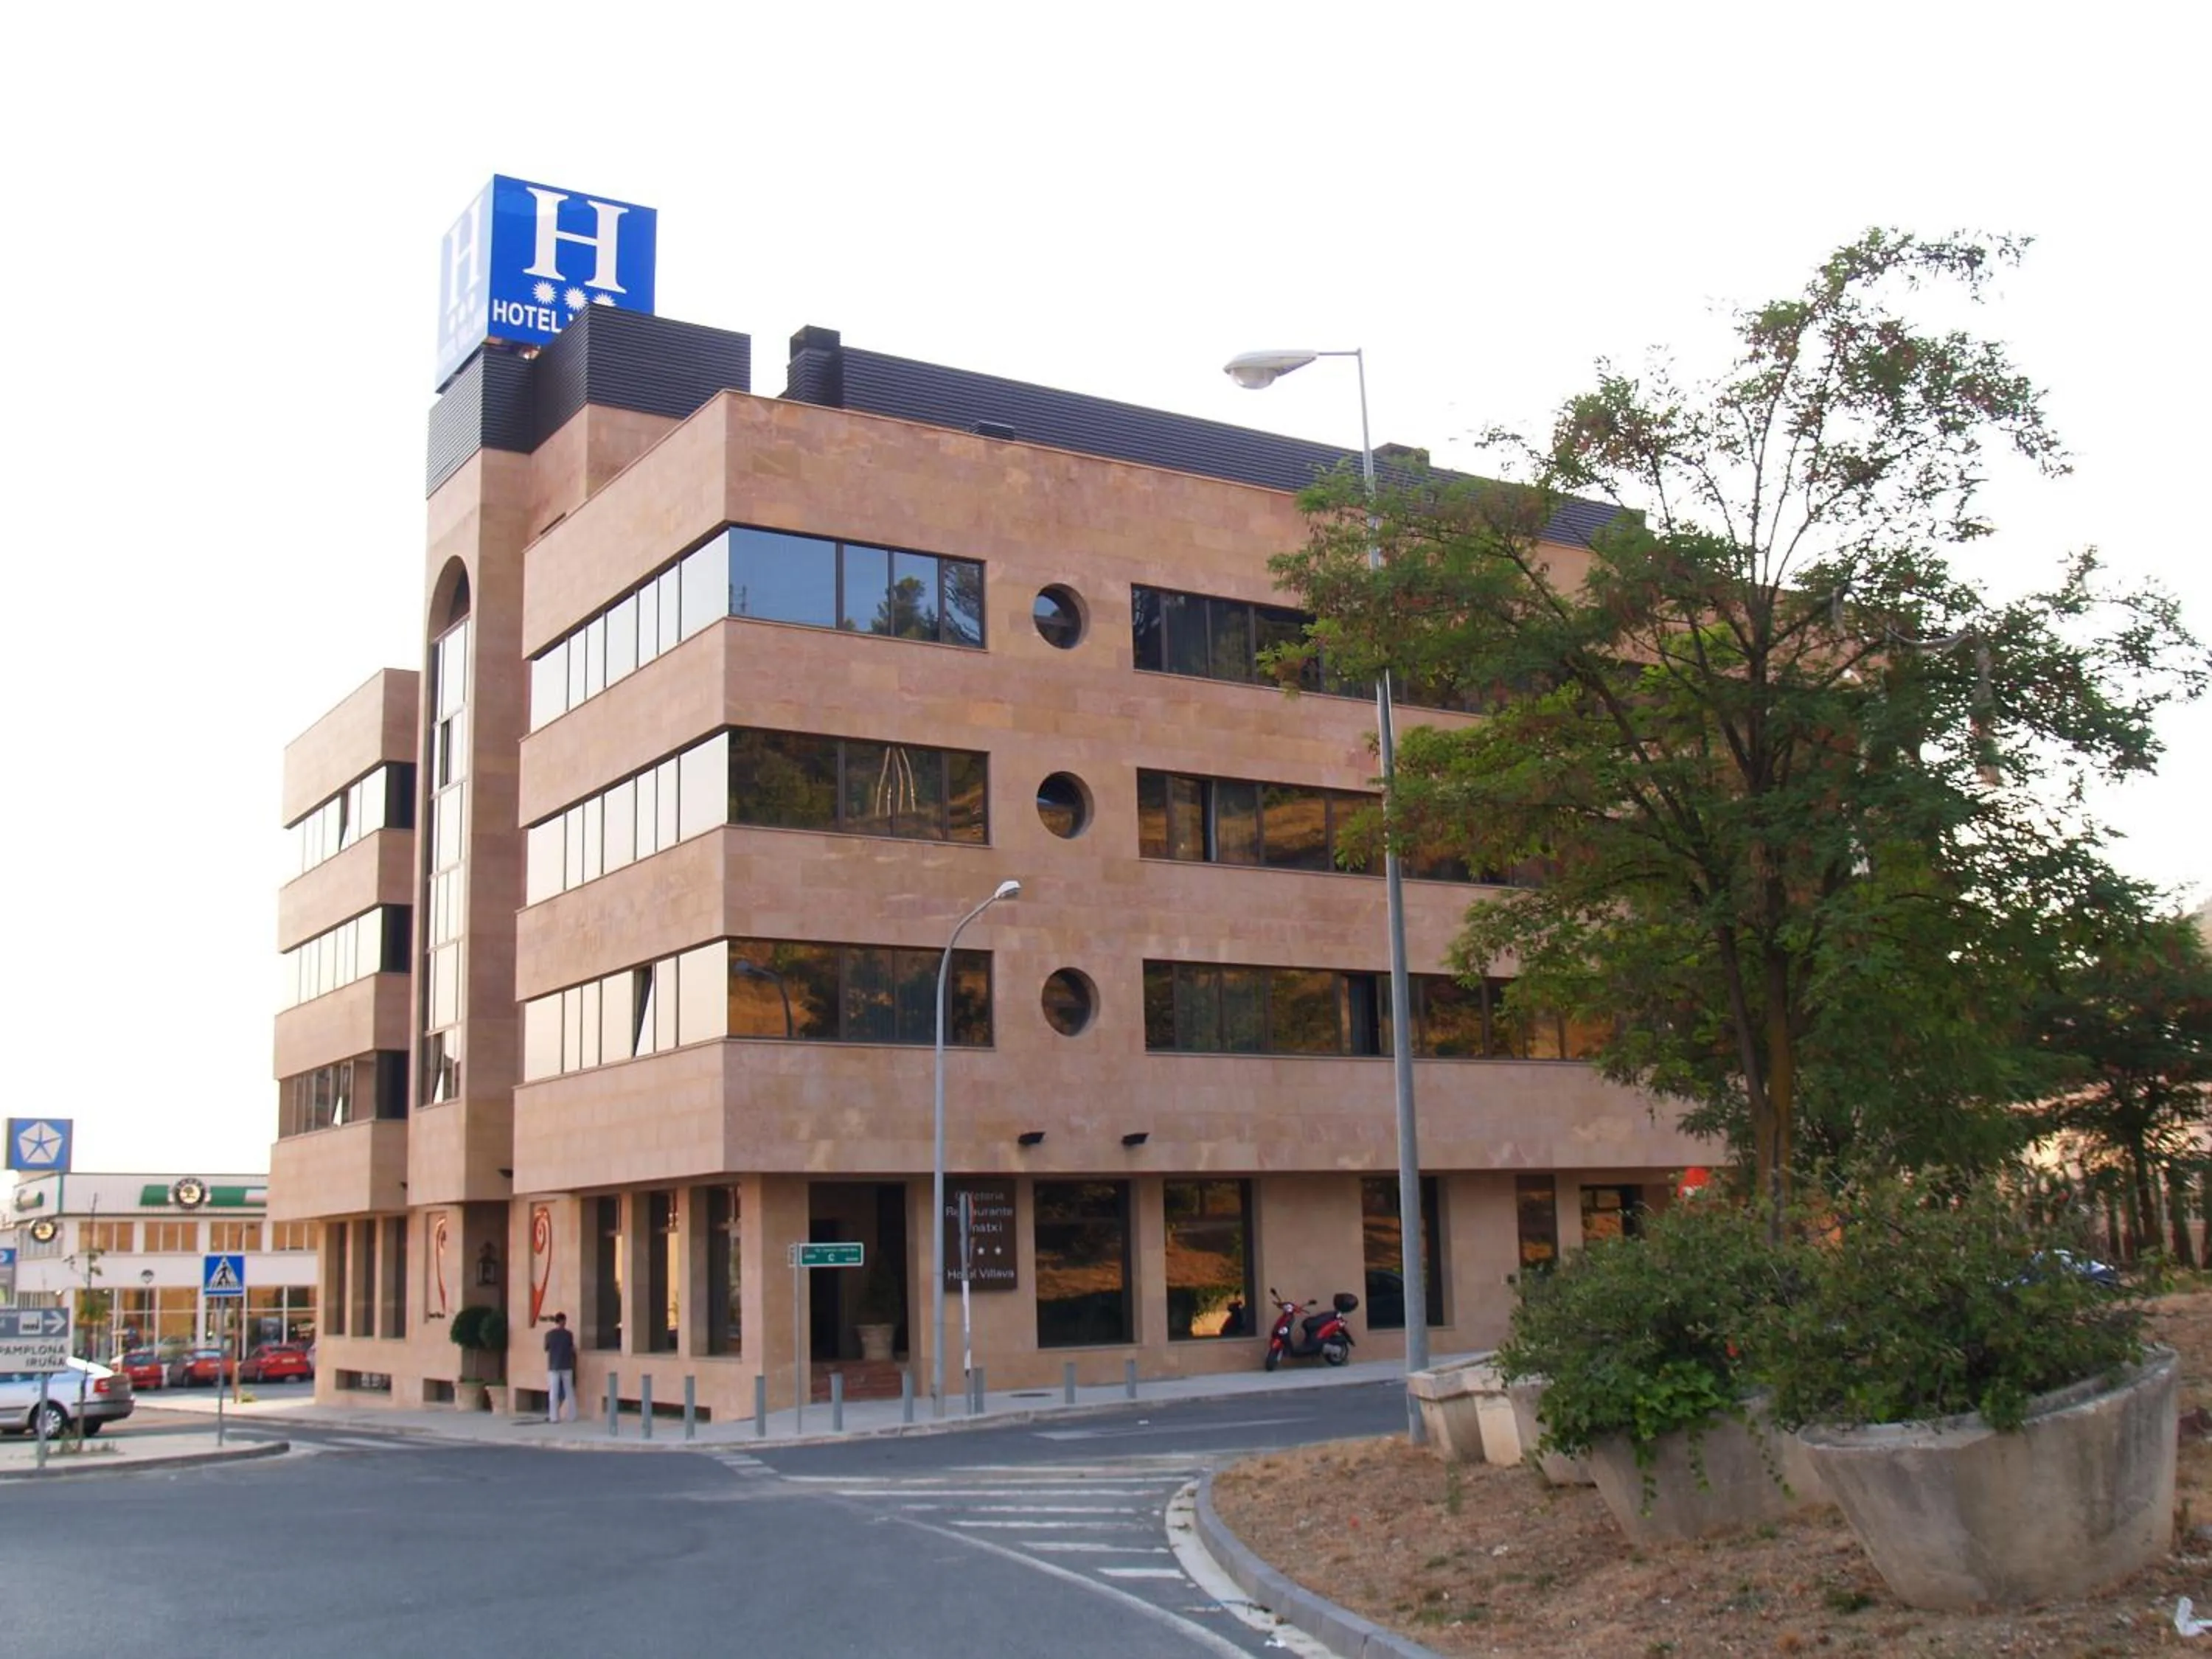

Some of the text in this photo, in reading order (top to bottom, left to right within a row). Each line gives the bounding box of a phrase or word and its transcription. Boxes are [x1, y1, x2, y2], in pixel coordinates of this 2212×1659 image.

[446, 195, 483, 314] H
[523, 187, 629, 294] H
[493, 298, 563, 333] HOTEL
[947, 1267, 1015, 1279] Hoel Villava
